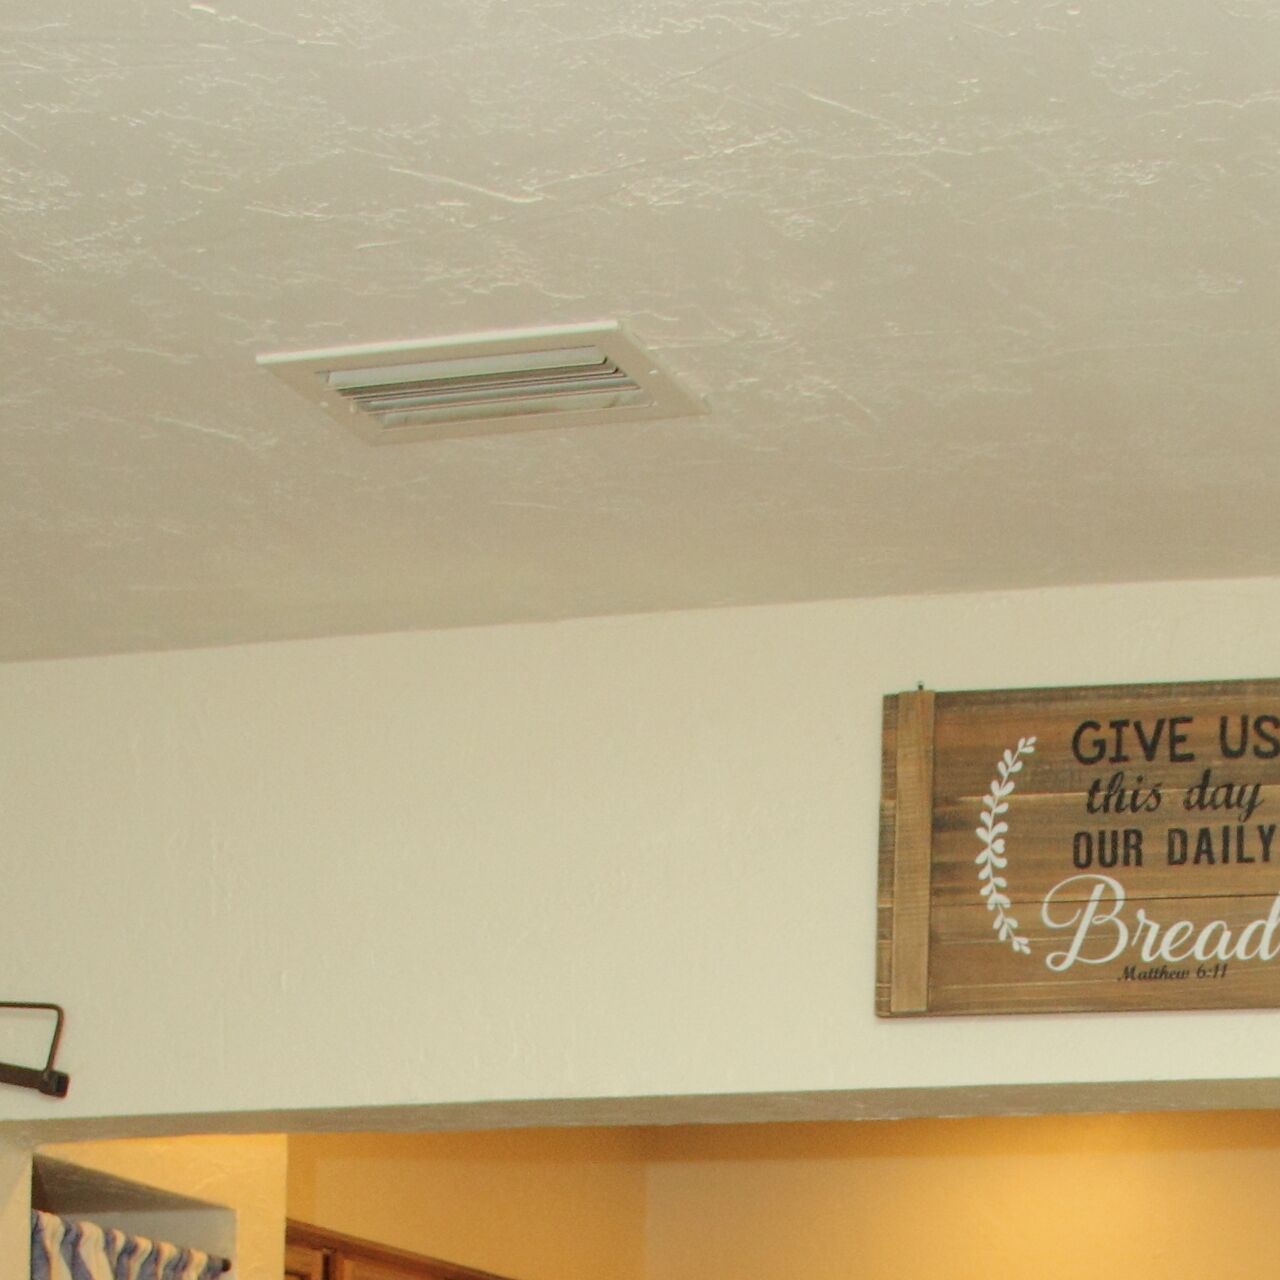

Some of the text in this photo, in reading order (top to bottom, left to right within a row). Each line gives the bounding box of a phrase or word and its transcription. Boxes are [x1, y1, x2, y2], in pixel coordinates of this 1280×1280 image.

[1072, 716, 1195, 765] GIVE
[1086, 769, 1265, 822] this day
[1073, 824, 1276, 868] OUR DAILY
[1117, 963, 1228, 981] Matthew 6:11
